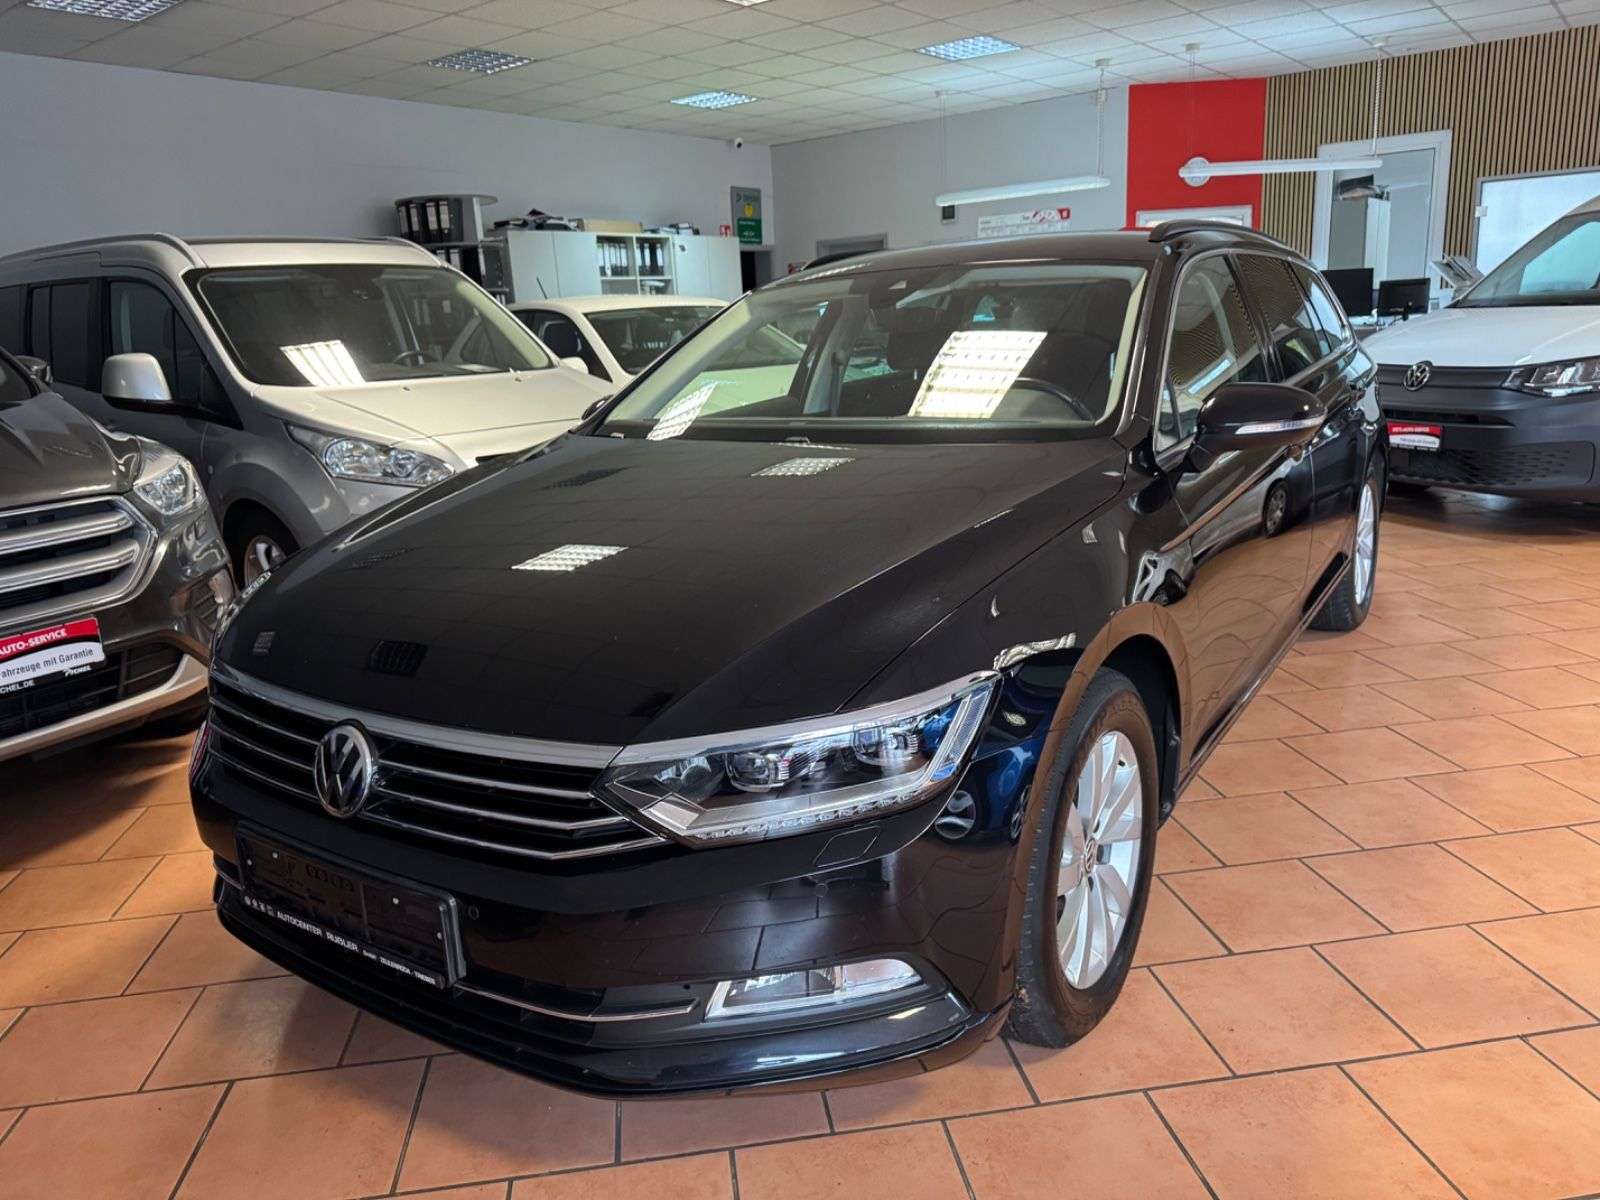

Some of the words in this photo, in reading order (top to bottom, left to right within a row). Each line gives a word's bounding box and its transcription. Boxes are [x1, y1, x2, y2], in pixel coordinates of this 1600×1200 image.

[0, 661, 41, 678] ahrzeuge
[43, 657, 57, 668] mit
[59, 647, 94, 664] Garantie
